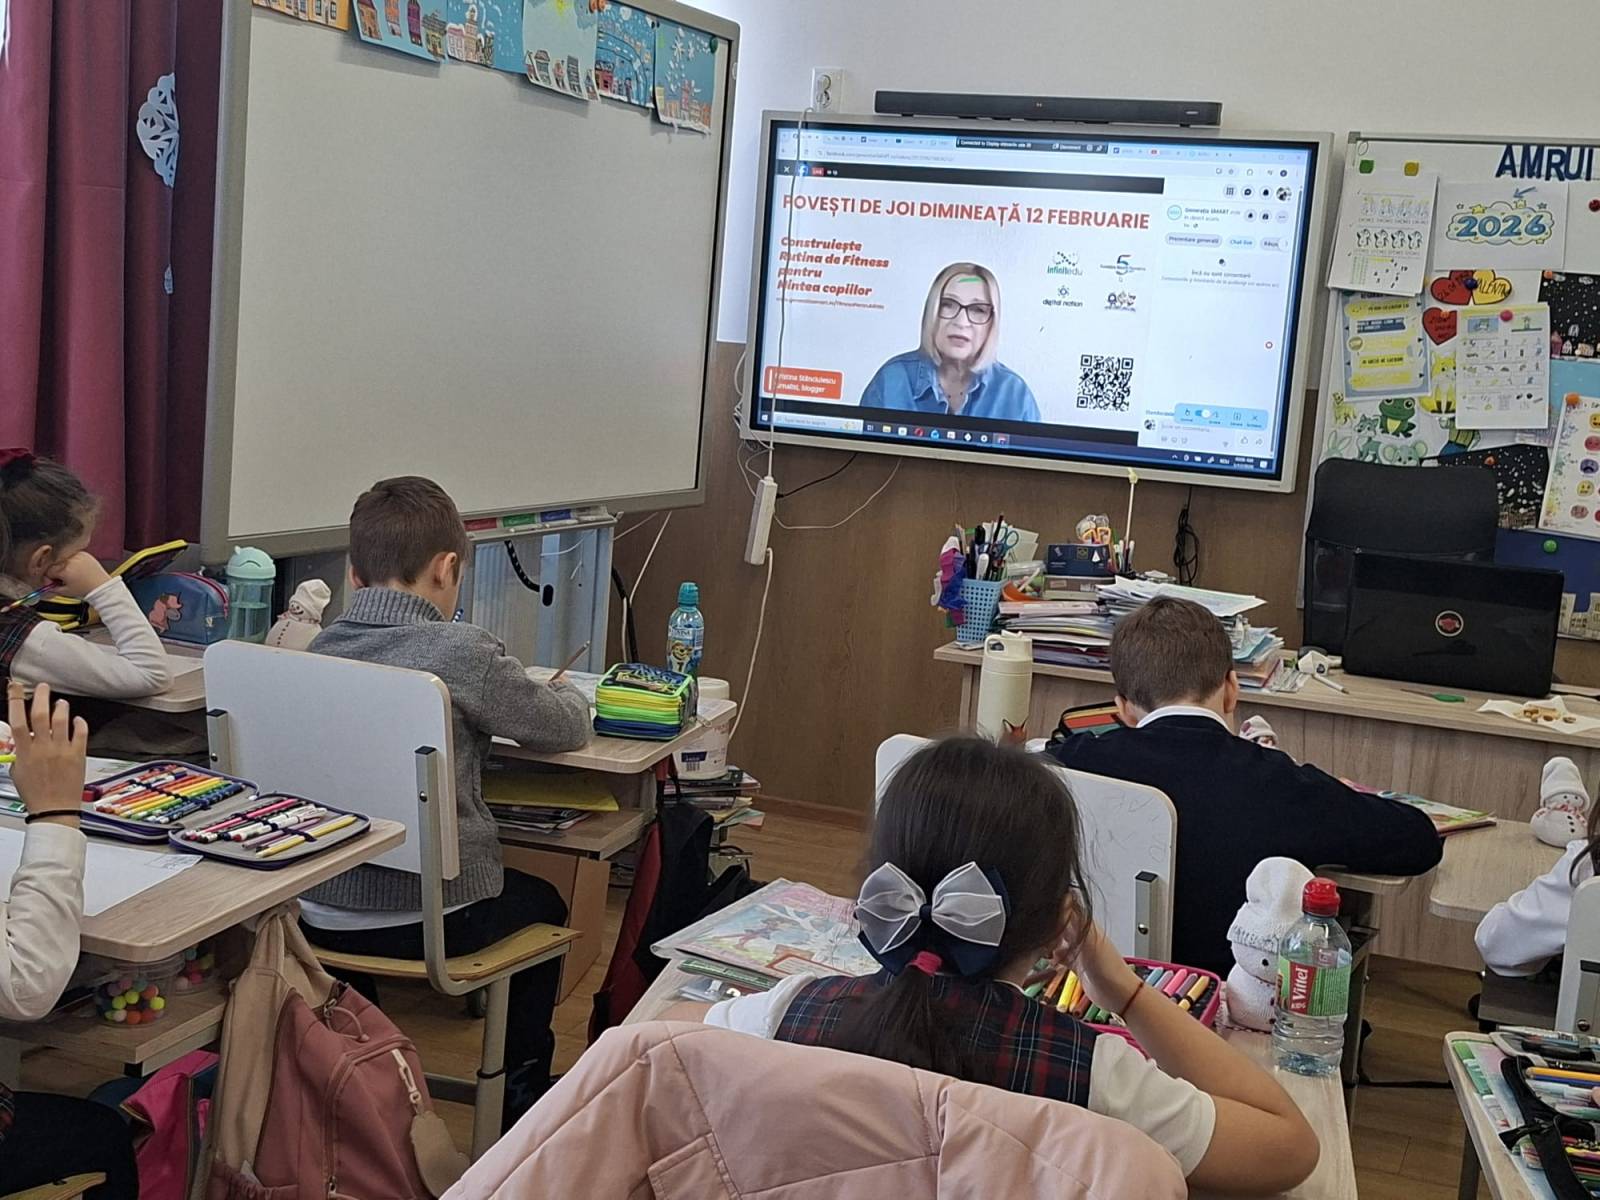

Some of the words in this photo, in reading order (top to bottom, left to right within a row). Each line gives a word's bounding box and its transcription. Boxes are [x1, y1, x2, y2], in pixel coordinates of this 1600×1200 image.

[783, 194, 855, 217] POVEȘTI
[859, 199, 882, 214] DE
[886, 201, 915, 216] JOI
[919, 202, 1021, 227] DIMINEAȚĂ
[1026, 207, 1044, 224] 12
[1047, 208, 1150, 230] FEBRUARIE
[1456, 214, 1547, 238] 2026
[779, 251, 823, 263] Rutina
[825, 254, 841, 264] de
[842, 254, 890, 268] Fitness
[777, 266, 823, 278] pentru
[822, 283, 873, 296] copiilor
[1042, 298, 1061, 307] digital
[1062, 300, 1083, 308] nation
[801, 383, 826, 394] blogger
[1292, 967, 1309, 1001] Vittel
